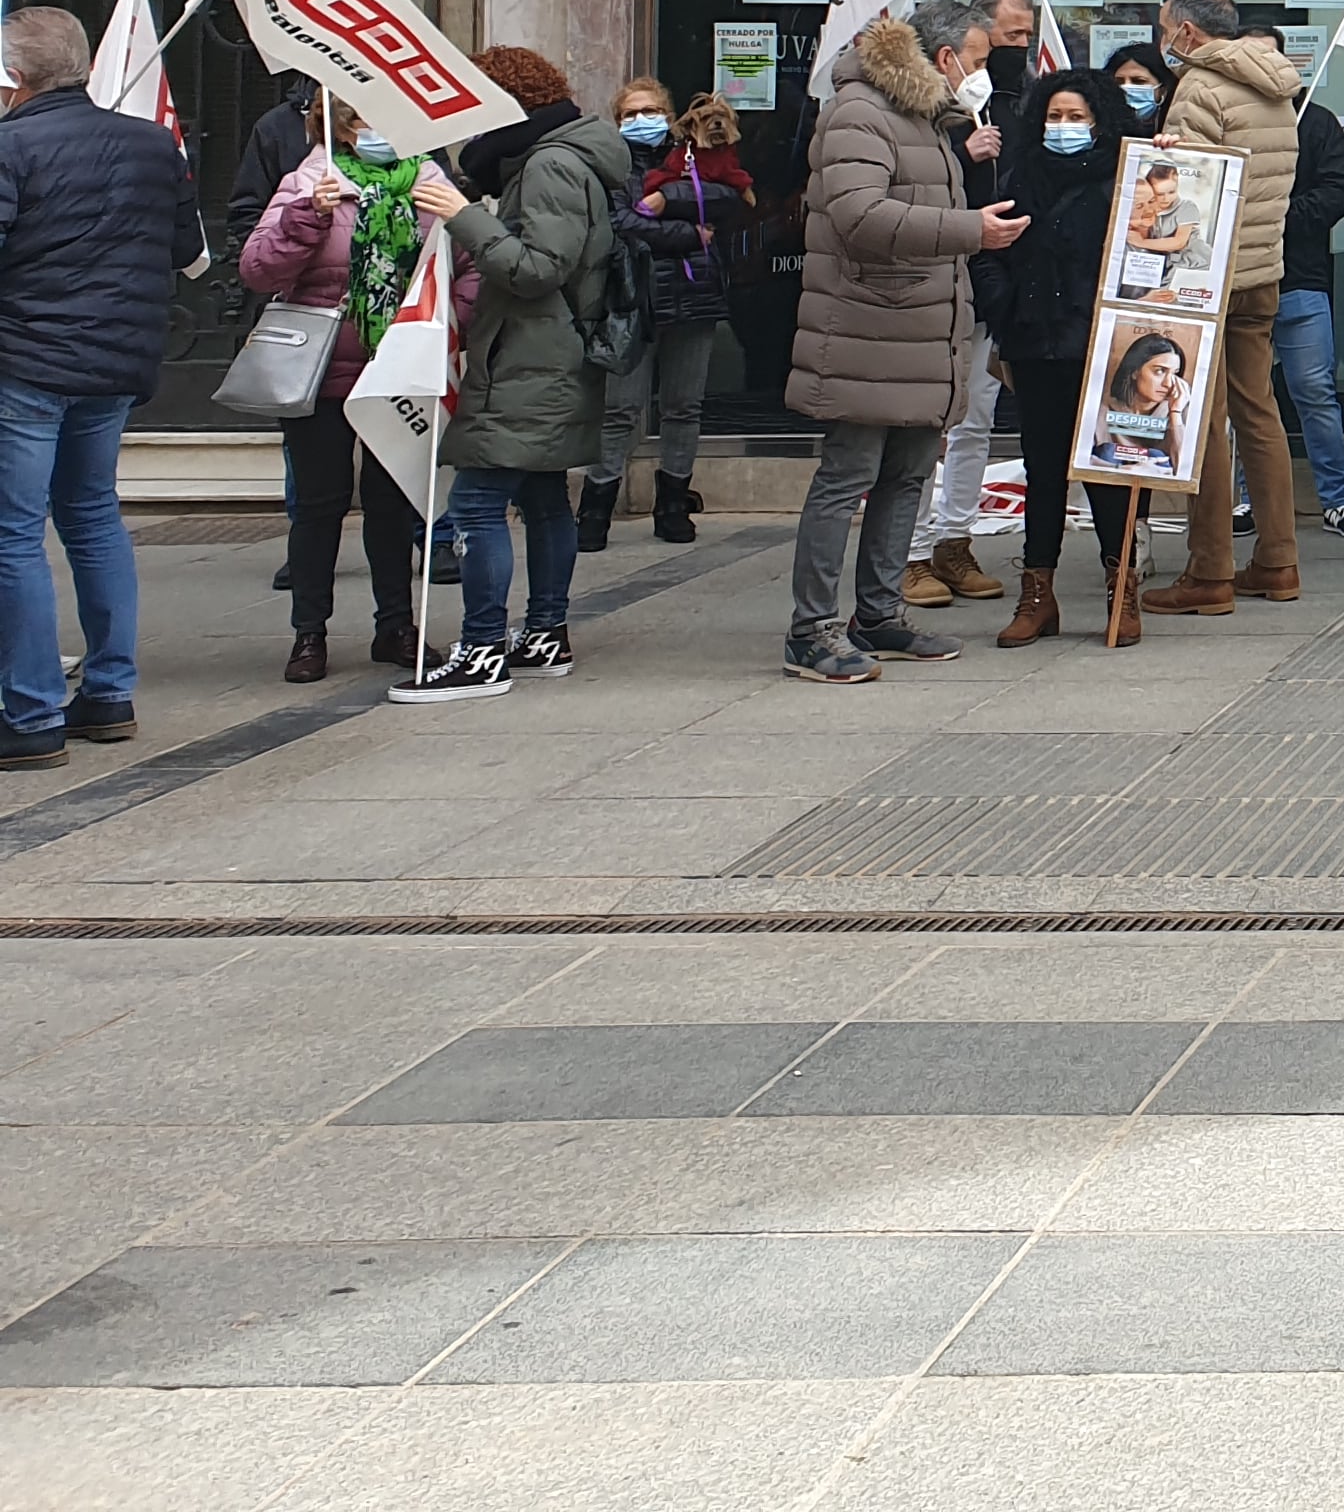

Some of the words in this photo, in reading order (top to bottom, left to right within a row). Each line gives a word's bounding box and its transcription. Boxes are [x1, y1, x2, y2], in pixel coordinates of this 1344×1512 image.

[717, 29, 754, 37] CERRADO
[757, 29, 774, 37] POR
[728, 39, 762, 47] HUELGA
[1106, 413, 1168, 429] DESPIDEN
